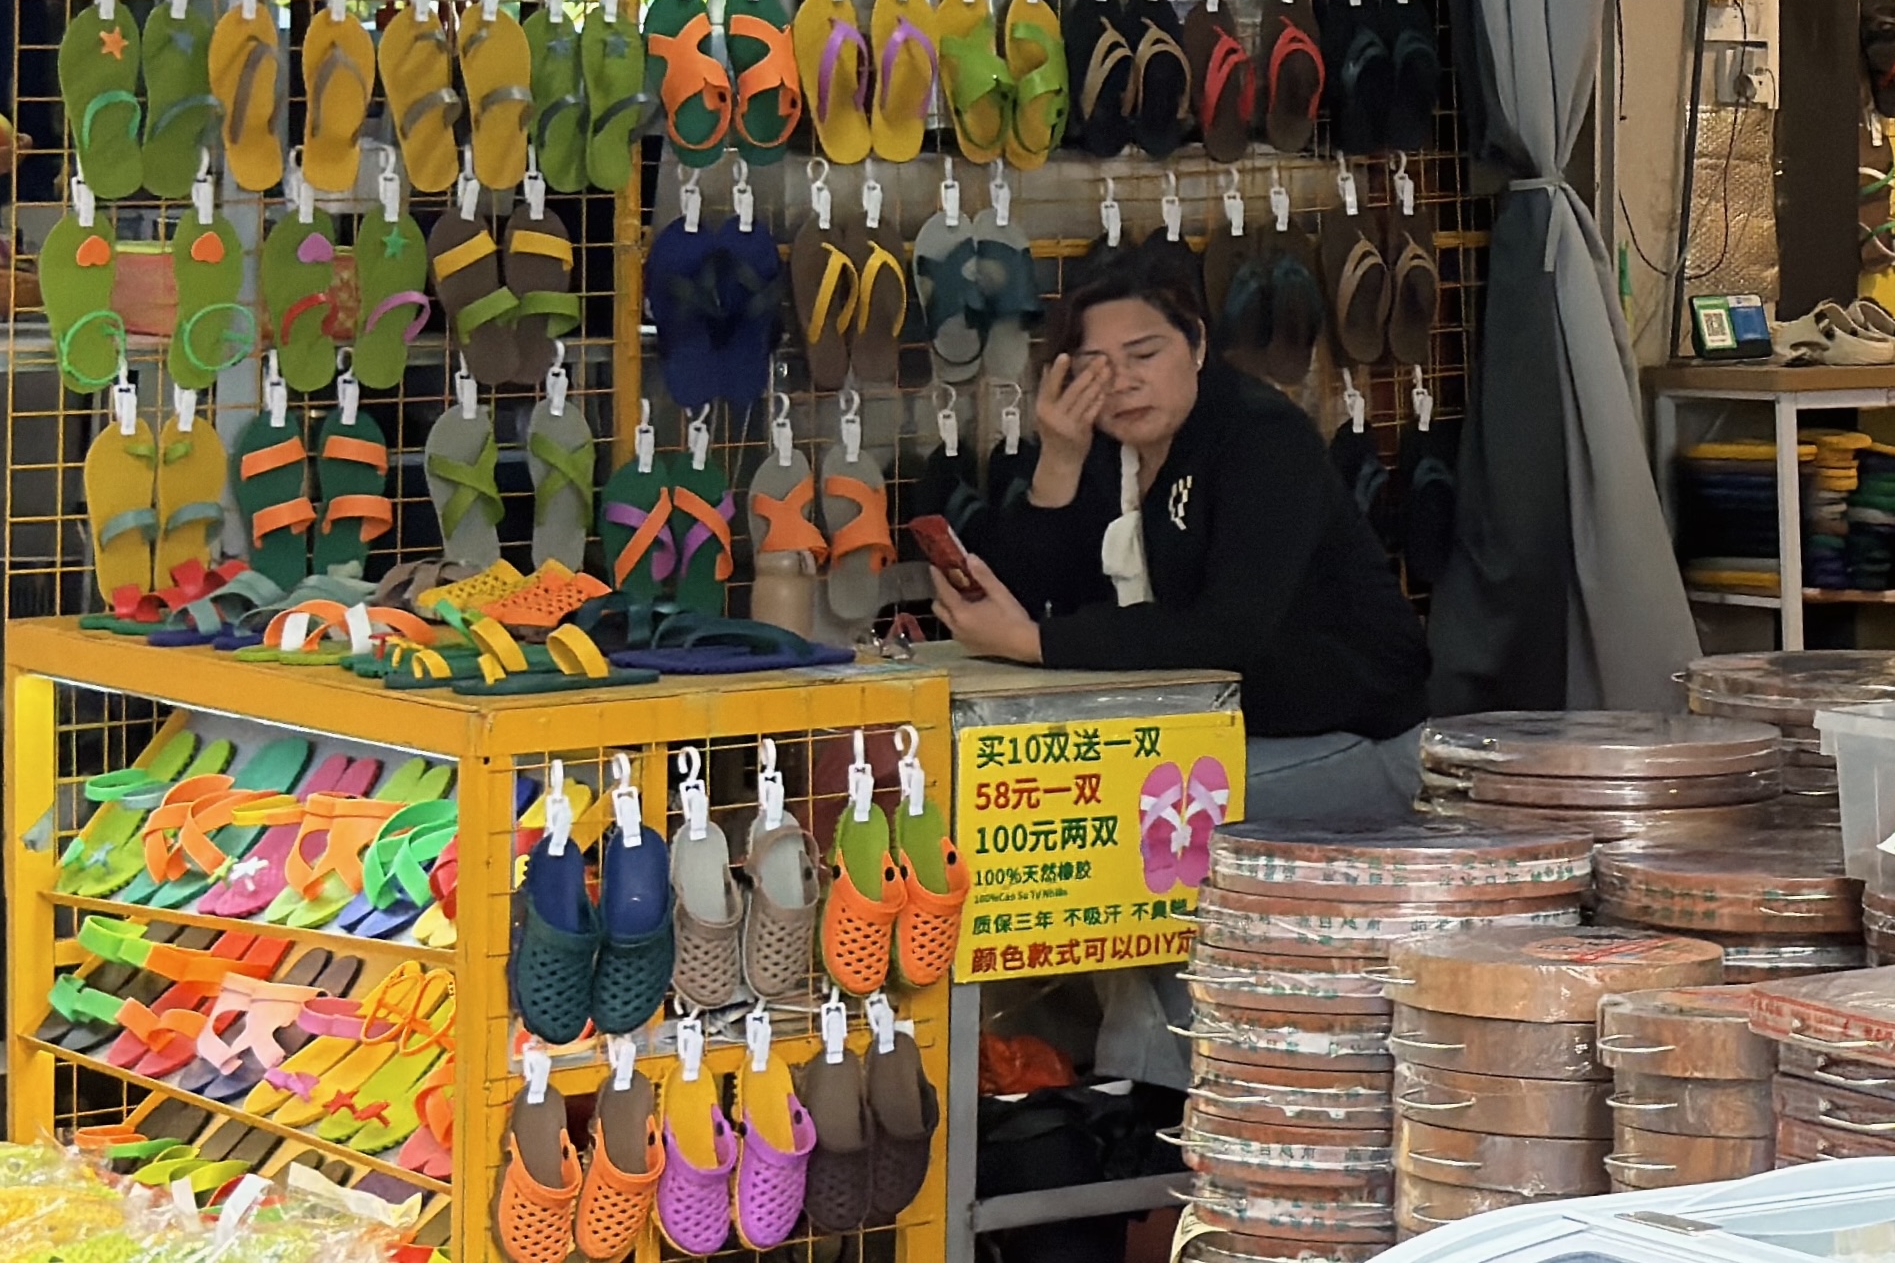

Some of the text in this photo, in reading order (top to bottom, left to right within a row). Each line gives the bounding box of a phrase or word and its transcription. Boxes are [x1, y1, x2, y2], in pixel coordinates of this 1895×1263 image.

[976, 726, 1162, 768] 买10双送一双
[975, 773, 1102, 811] 58元一双
[975, 816, 1119, 855] 100元两双
[974, 860, 1092, 886] 100%天然橡胶
[972, 911, 1054, 936] 质保三年
[1063, 903, 1122, 927] 不吸汗
